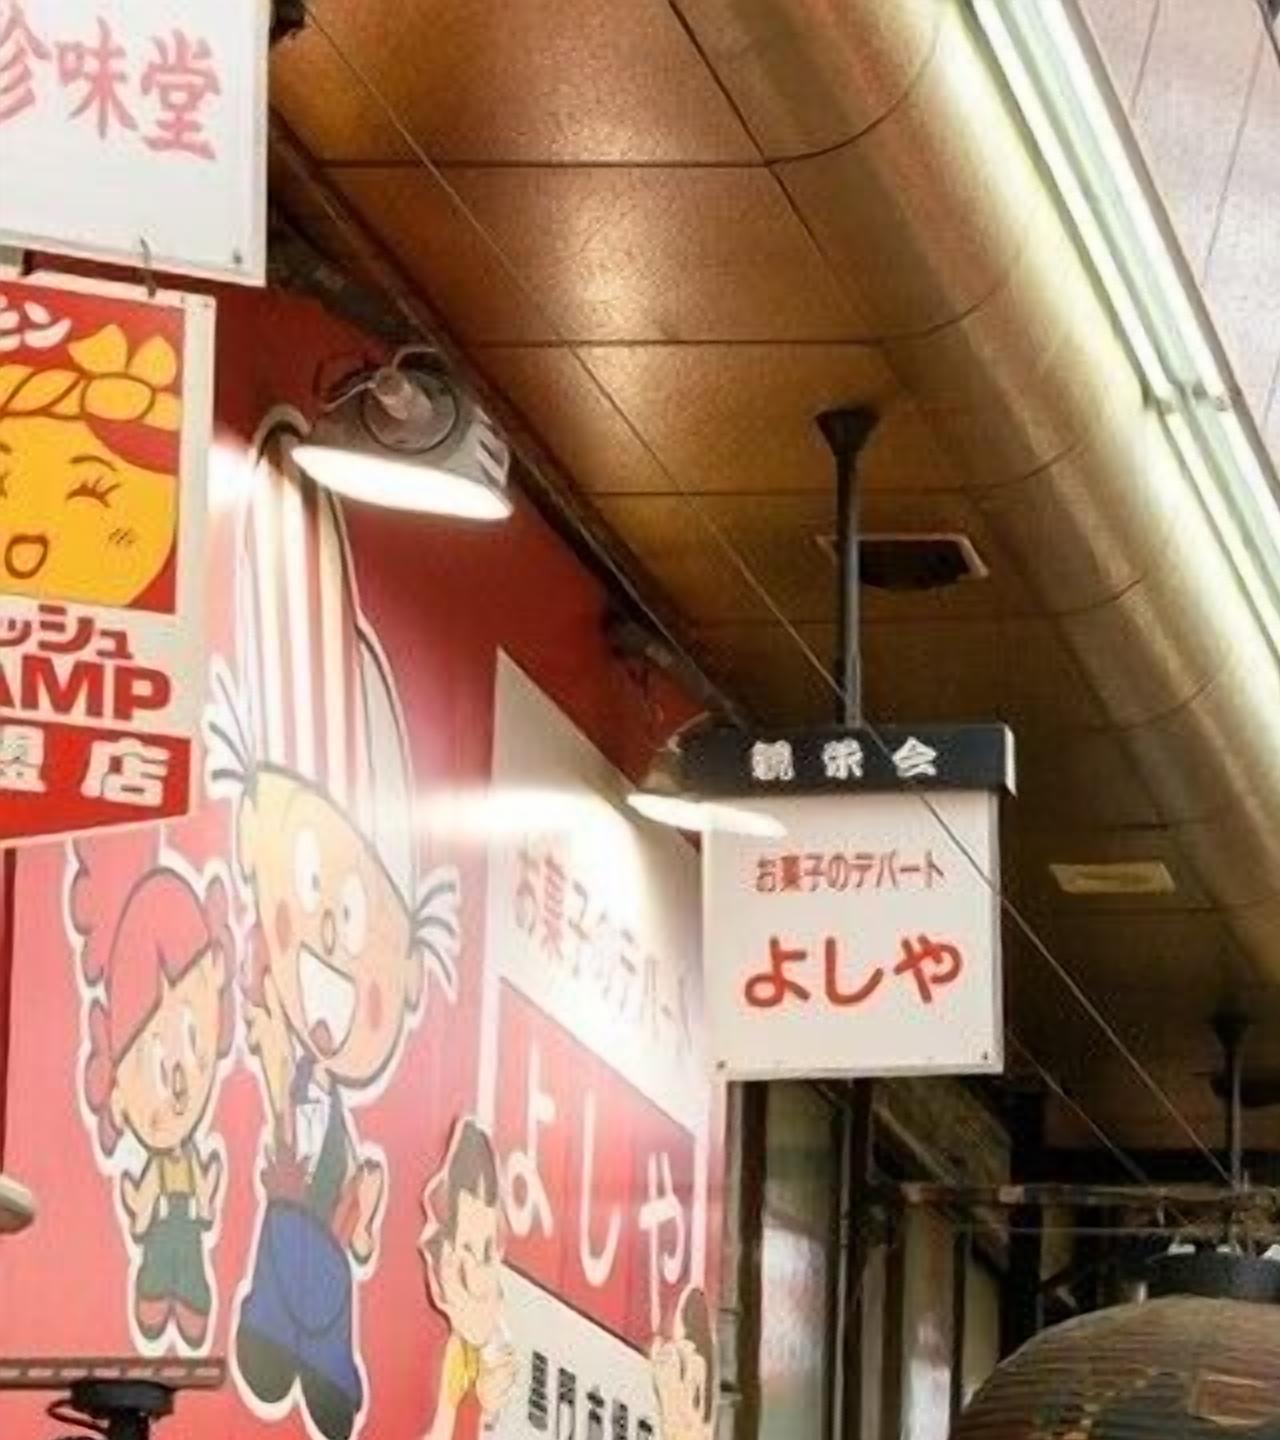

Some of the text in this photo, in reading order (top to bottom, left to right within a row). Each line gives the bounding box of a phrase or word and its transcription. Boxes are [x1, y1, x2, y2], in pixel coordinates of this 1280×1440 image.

[744, 935, 964, 1008] よしや
[502, 1040, 685, 1336] よしや
